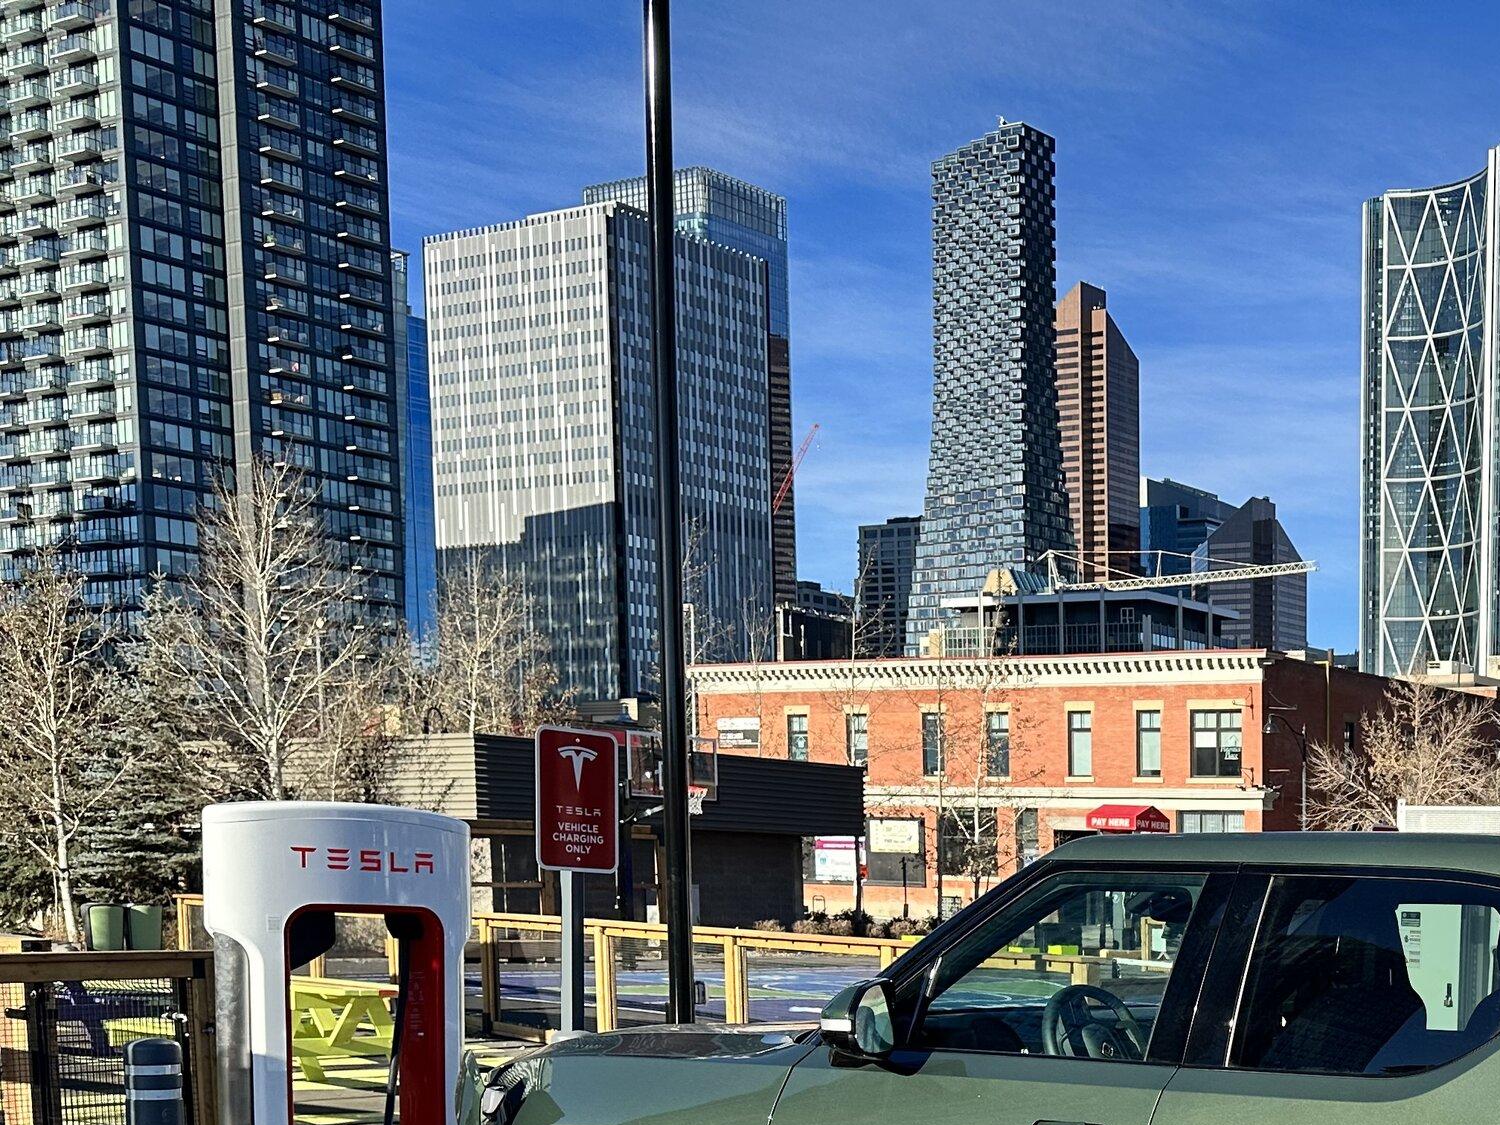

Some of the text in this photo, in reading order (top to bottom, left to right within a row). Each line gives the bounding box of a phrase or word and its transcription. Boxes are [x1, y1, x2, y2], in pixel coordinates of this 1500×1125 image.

[556, 805, 601, 817] TESLA
[558, 821, 599, 834] VEHICLE
[1091, 817, 1130, 827] PAY HERE
[1137, 820, 1169, 830] PAY HERE
[552, 832, 604, 845] CHARGING
[565, 844, 592, 854] ONLY
[290, 847, 433, 874] TESLA
